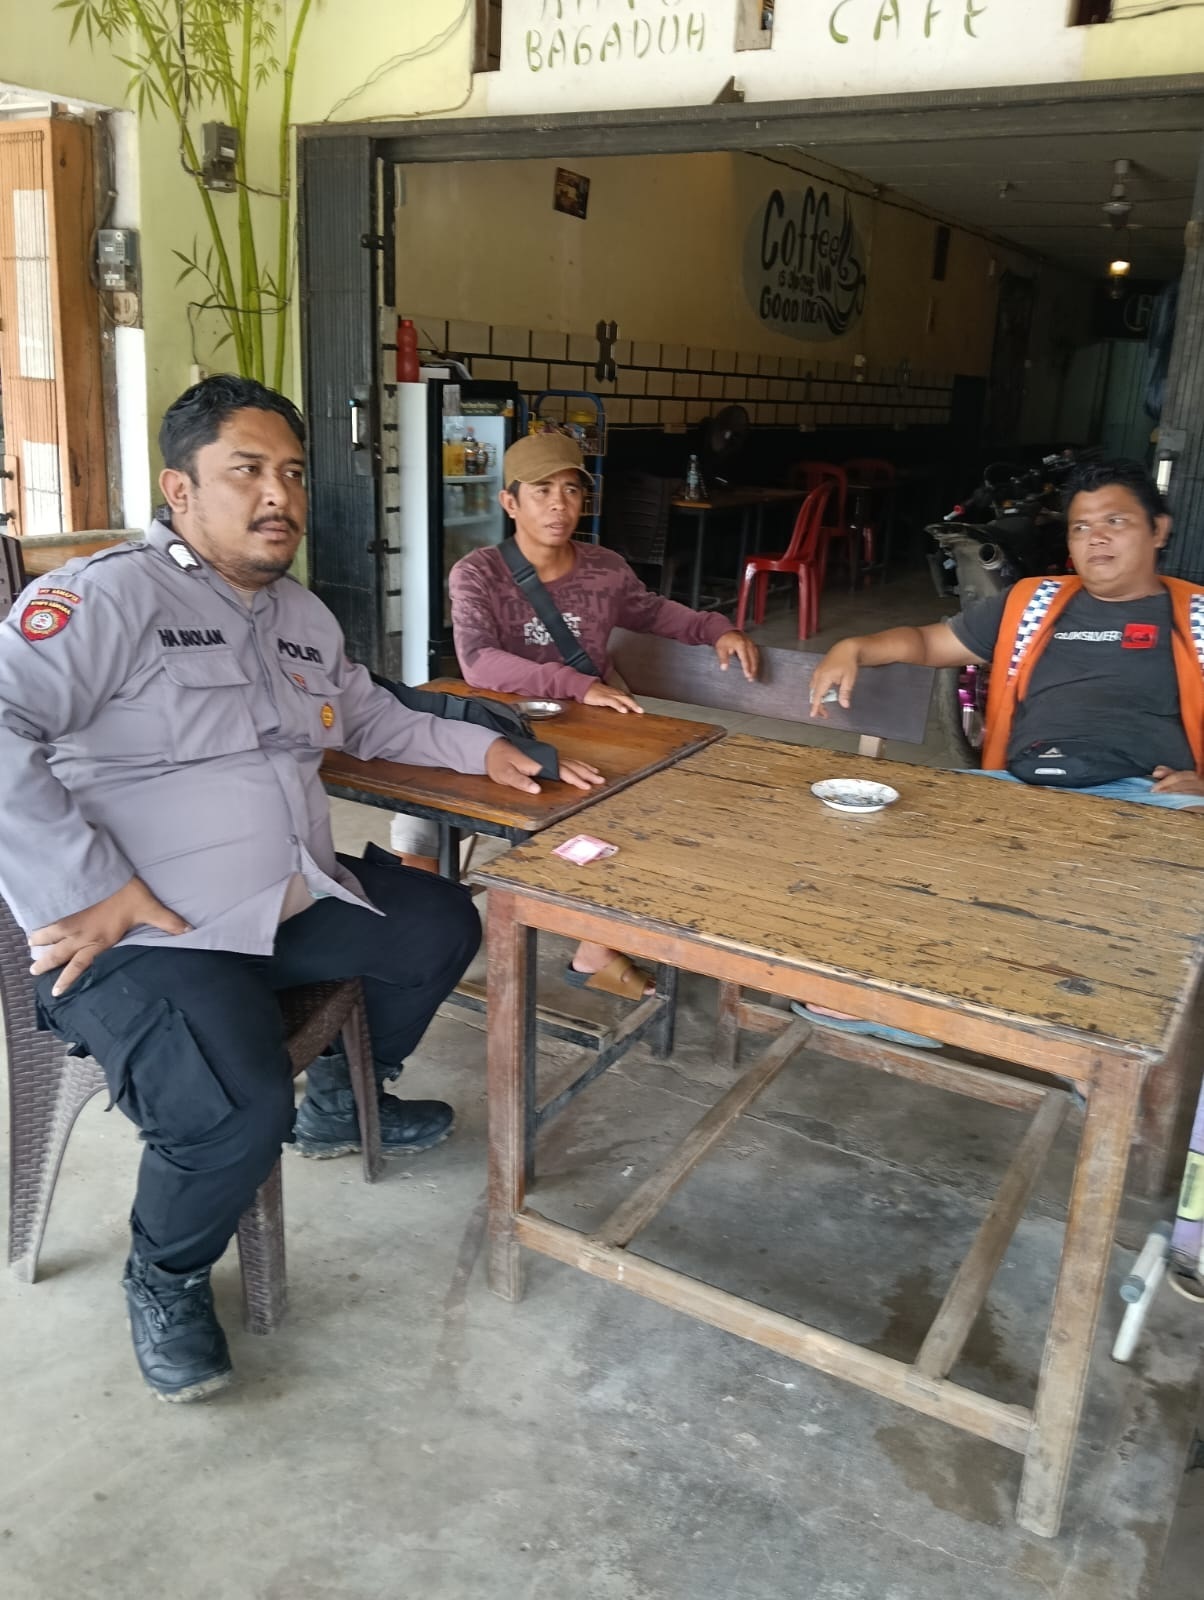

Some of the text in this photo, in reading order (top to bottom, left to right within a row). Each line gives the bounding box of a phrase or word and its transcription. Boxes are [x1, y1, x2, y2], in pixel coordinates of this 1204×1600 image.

[526, 12, 705, 72] BAGADUH
[761, 186, 839, 273] Coffee
[277, 638, 324, 664] POLRI
